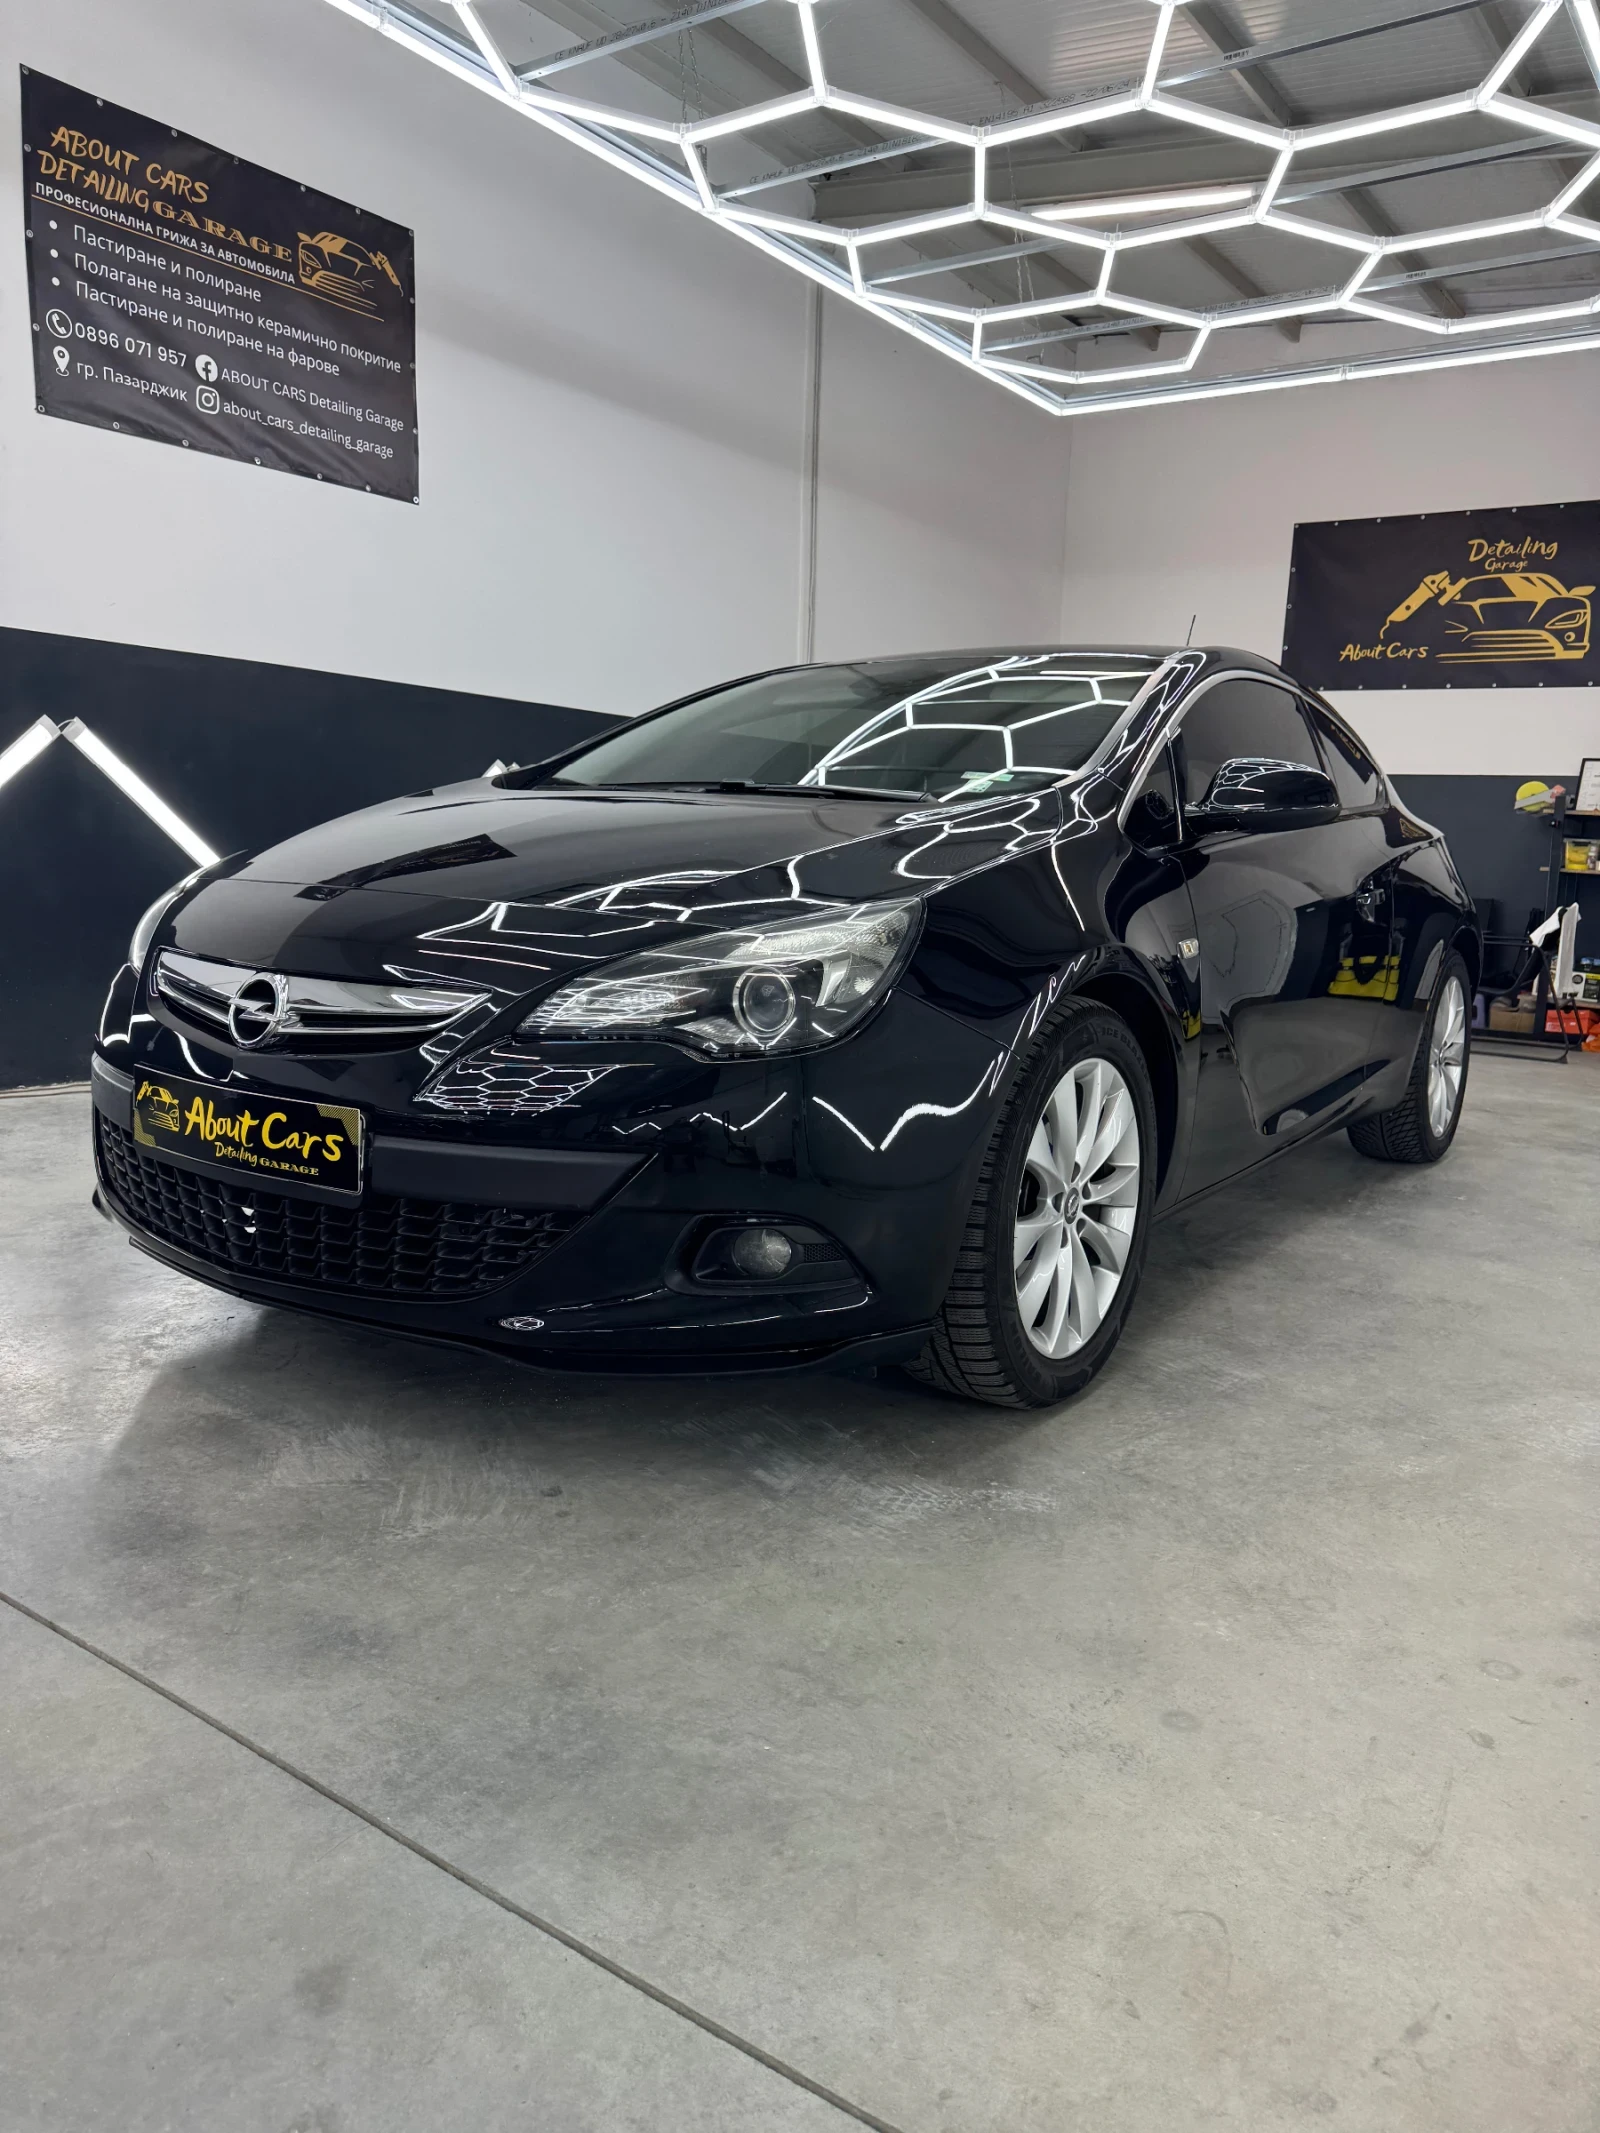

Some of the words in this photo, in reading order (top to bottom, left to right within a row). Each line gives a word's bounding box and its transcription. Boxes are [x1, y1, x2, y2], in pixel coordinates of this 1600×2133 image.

[50, 126, 139, 172] ABOUT
[146, 162, 209, 204] CARS
[35, 182, 154, 234] ПРОФЕСИОНАЛНА
[156, 226, 198, 250] ГРИЖА
[201, 241, 215, 254] ЗА
[217, 246, 295, 284] АВТОМОБИЛА
[37, 150, 150, 213] DETAILING
[153, 200, 293, 262] GARAGE
[74, 225, 166, 270] Пастиране
[173, 258, 182, 273] и
[186, 264, 261, 302] полиране
[75, 253, 157, 297] Полагане
[162, 285, 181, 299] на
[186, 293, 254, 324] защитно
[258, 315, 338, 352] керамично
[340, 341, 401, 373] покритие
[77, 281, 168, 324] Пастиране
[173, 314, 182, 328] и
[187, 318, 262, 353] полиране
[267, 343, 283, 358] на
[288, 347, 339, 376] фарове
[75, 323, 119, 349] 0896
[126, 336, 151, 358] 071
[158, 346, 187, 367] 957
[77, 362, 98, 380] гр.
[104, 367, 187, 402] Пазарджик
[222, 368, 268, 392] ABOUT
[272, 382, 306, 402] CARS
[310, 392, 363, 421] Detailing
[365, 408, 404, 432] Garage
[223, 400, 393, 459] about_cars_detailing_garage
[1468, 536, 1558, 562] Detailing
[1484, 558, 1528, 572] Garage
[1339, 642, 1385, 661] About
[1386, 642, 1428, 660] Cars
[1102, 1026, 1118, 1039] ICE
[184, 1096, 259, 1147] About
[262, 1112, 344, 1162] Cars
[214, 1142, 257, 1167] Detailing
[259, 1158, 319, 1176] GARAGE
